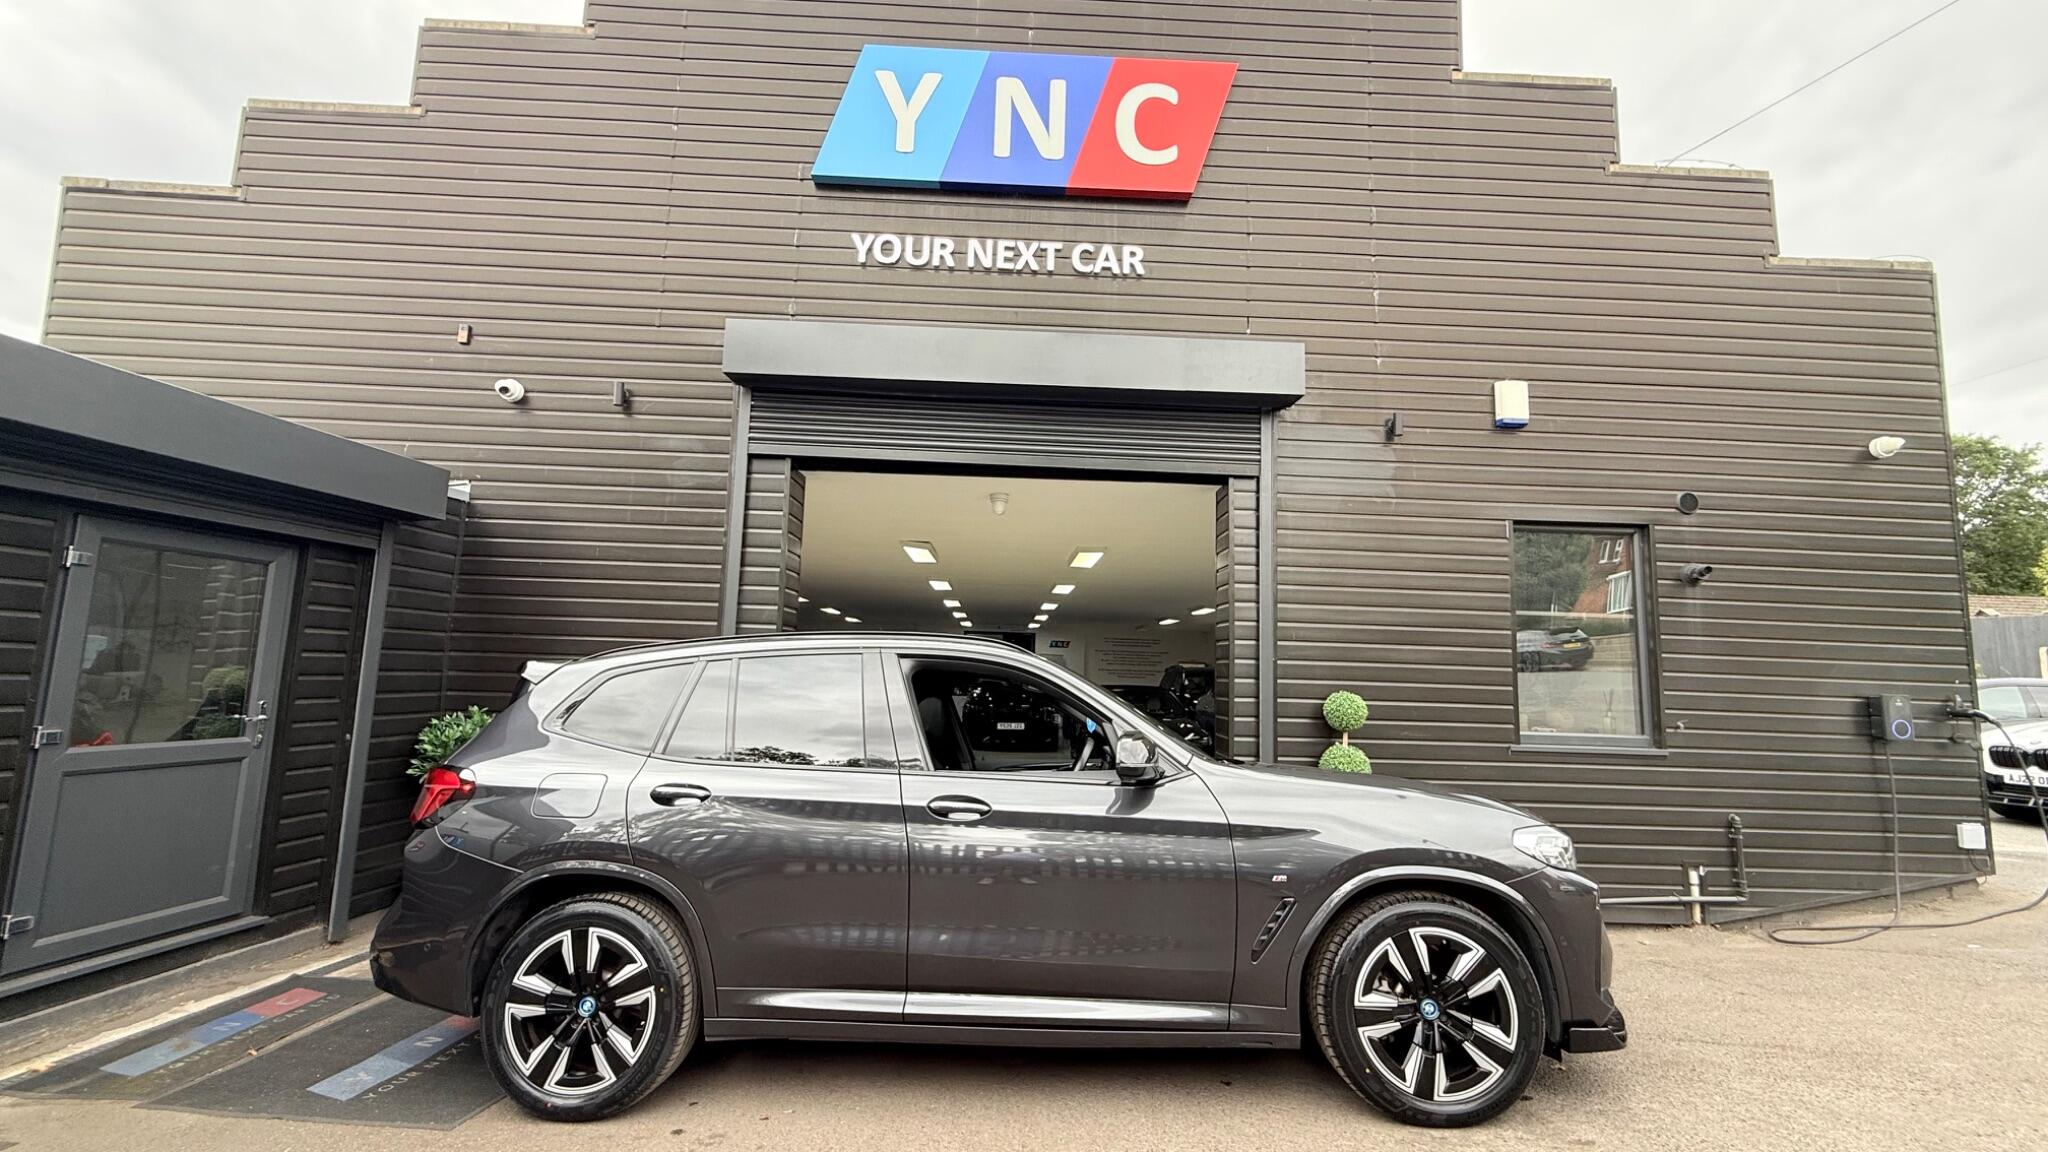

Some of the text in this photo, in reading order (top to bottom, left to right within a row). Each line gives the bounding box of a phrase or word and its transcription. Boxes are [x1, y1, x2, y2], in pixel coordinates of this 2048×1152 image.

[875, 70, 1179, 165] YNC
[851, 232, 1146, 276] YOUR NEXT CAR
[361, 1041, 471, 1099] YOUR NEXT
